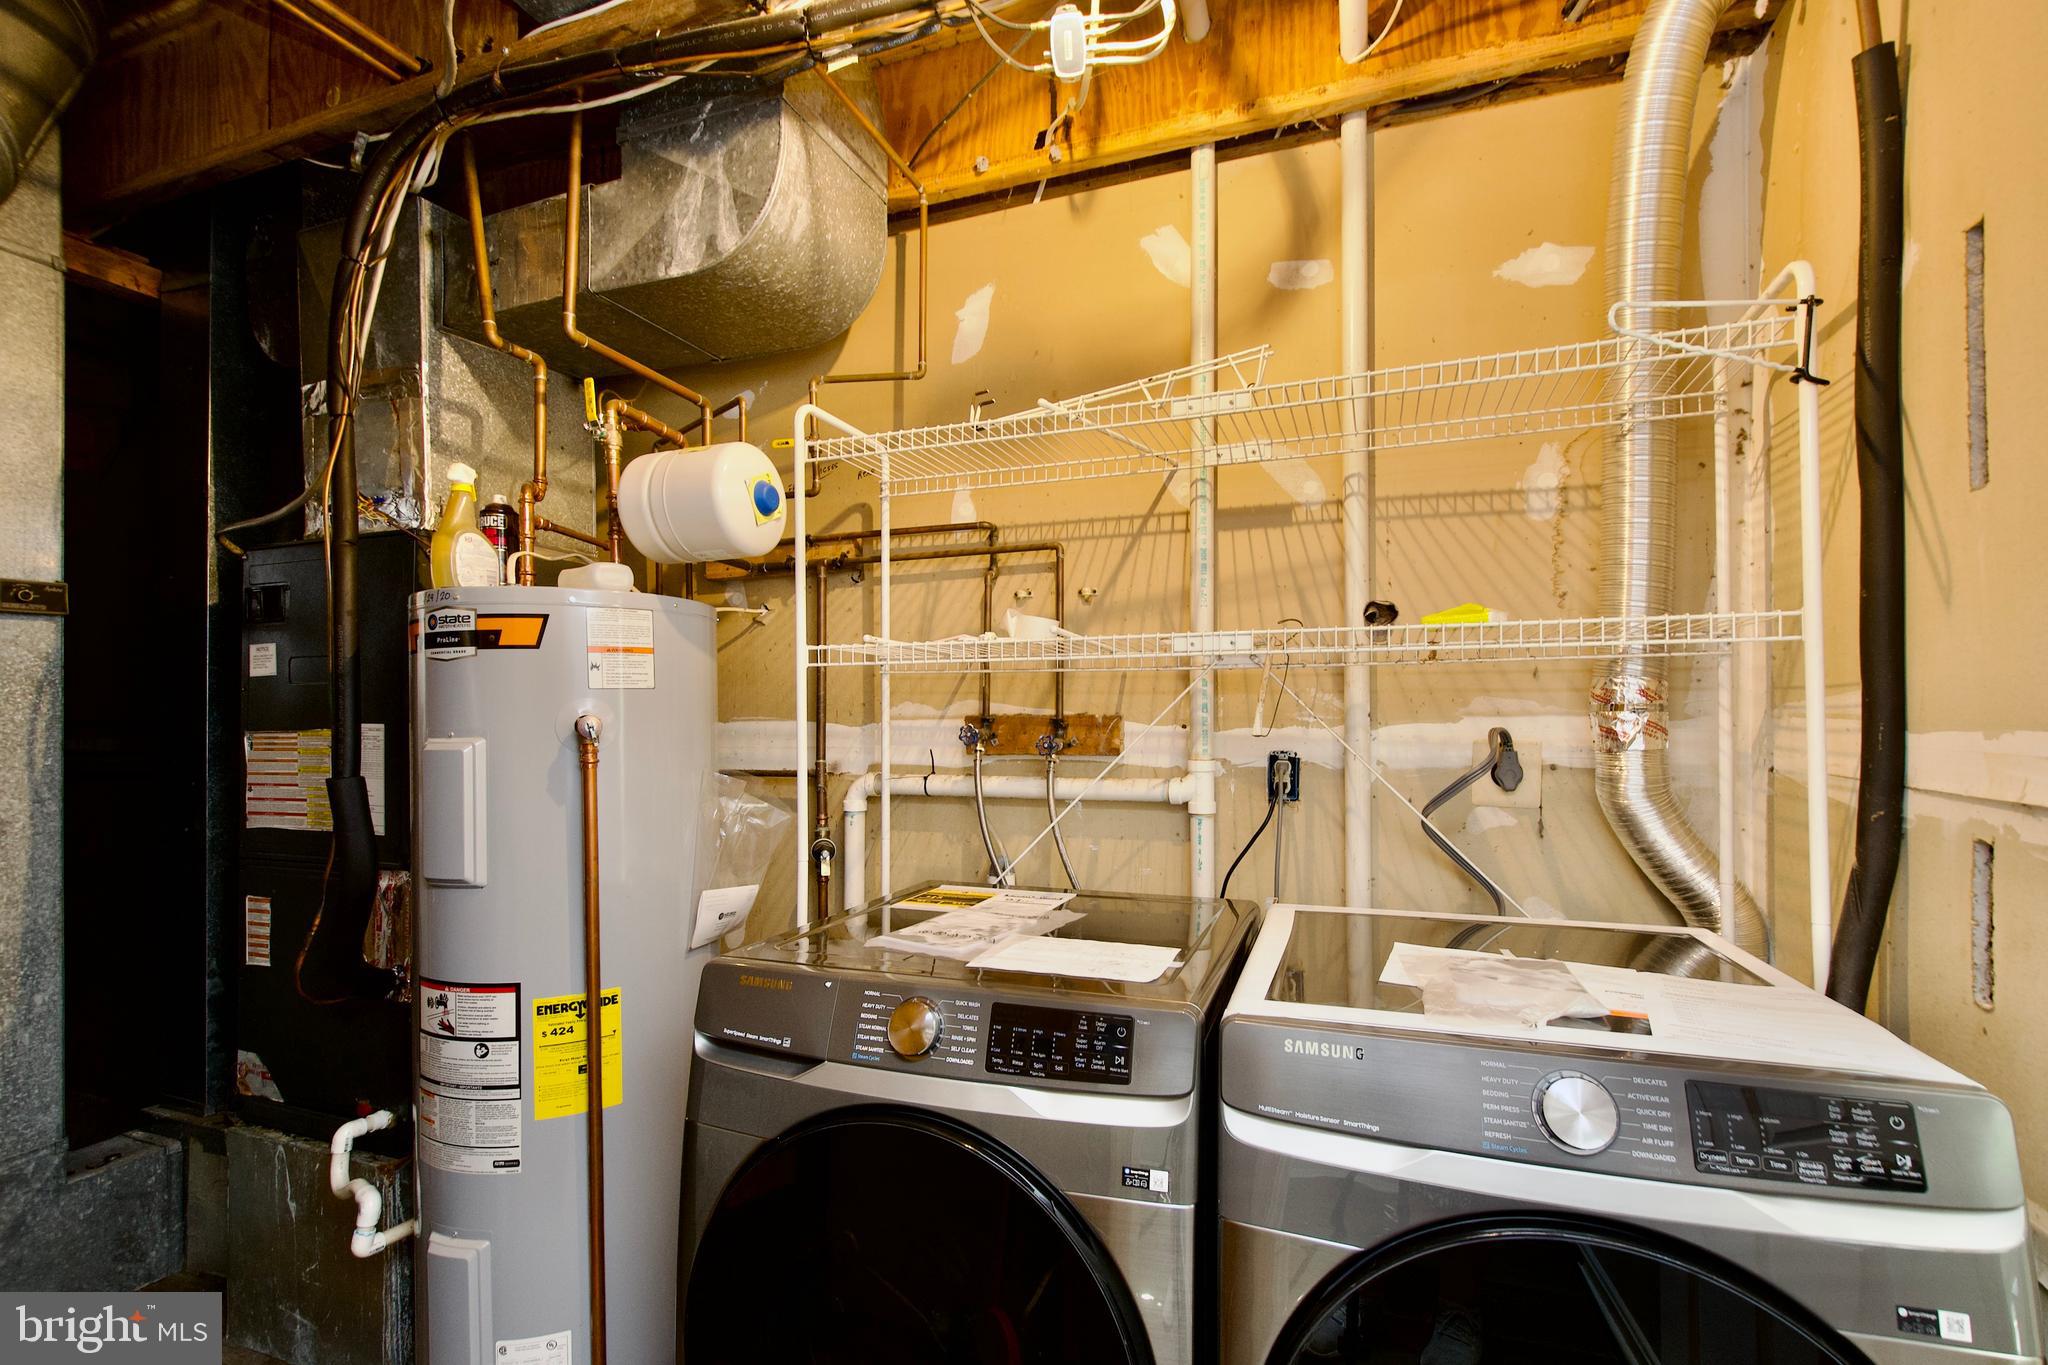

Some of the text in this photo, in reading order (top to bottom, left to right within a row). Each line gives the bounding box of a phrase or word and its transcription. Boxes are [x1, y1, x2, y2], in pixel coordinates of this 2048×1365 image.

[438, 615, 471, 624] state
[739, 975, 793, 992] SAMSUNG
[957, 1013, 979, 1021] DELICATES
[550, 1026, 574, 1036] 424
[1284, 1039, 1364, 1061] SAMSUNG
[946, 1056, 974, 1065] DOWNLOADED
[1481, 1060, 1506, 1068] NORMAL
[1481, 1075, 1518, 1085] HEAVY DUTY
[1633, 1076, 1668, 1087] DELICATES
[1482, 1090, 1509, 1098] BEDDING
[1628, 1093, 1670, 1104] ACTIVEWEAR
[1483, 1103, 1520, 1113] PERM PRESS
[1636, 1108, 1671, 1118] QUICK DRY
[1295, 1111, 1319, 1121] Moisture
[1319, 1115, 1340, 1124] Sensor
[1343, 1119, 1380, 1132] SmartThings
[1484, 1117, 1503, 1126] STEAM
[1642, 1122, 1673, 1133] TIME DRY
[1485, 1131, 1512, 1140] REFRESH
[1642, 1137, 1674, 1148] AIR FLUFF
[1490, 1142, 1528, 1154] Steam Cycles
[1632, 1150, 1676, 1163] DOWNLOADED
[1700, 1152, 1727, 1162] Dryness
[1736, 1156, 1755, 1166] Temp.
[1770, 1160, 1788, 1169] Time
[1798, 1161, 1824, 1170] Wrinkle
[1835, 1162, 1852, 1170] Light
[1799, 1168, 1826, 1177] Prevent
